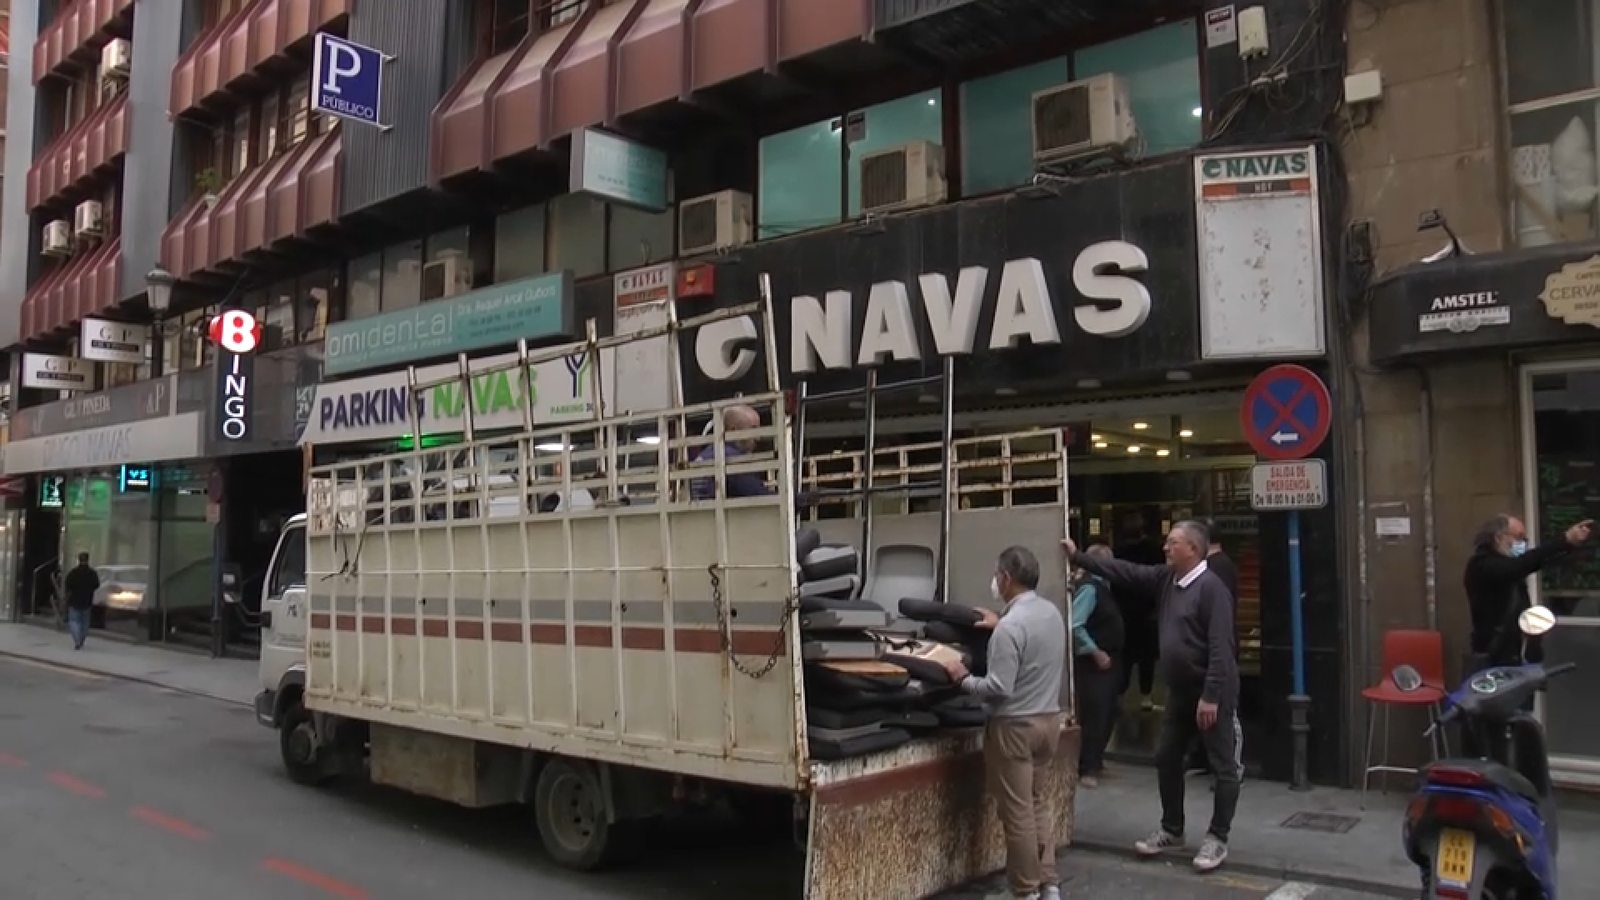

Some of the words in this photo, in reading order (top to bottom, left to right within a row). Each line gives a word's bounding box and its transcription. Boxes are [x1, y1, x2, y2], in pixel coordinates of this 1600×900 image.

[323, 39, 361, 94] P
[322, 94, 374, 119] PÚBLICO
[1226, 153, 1306, 177] NAVAS
[791, 240, 1152, 374] NAVAS
[1431, 291, 1497, 310] AMSTEL
[329, 305, 453, 357] omidental
[320, 383, 425, 431] PARKING
[432, 366, 538, 419] NAVAS
